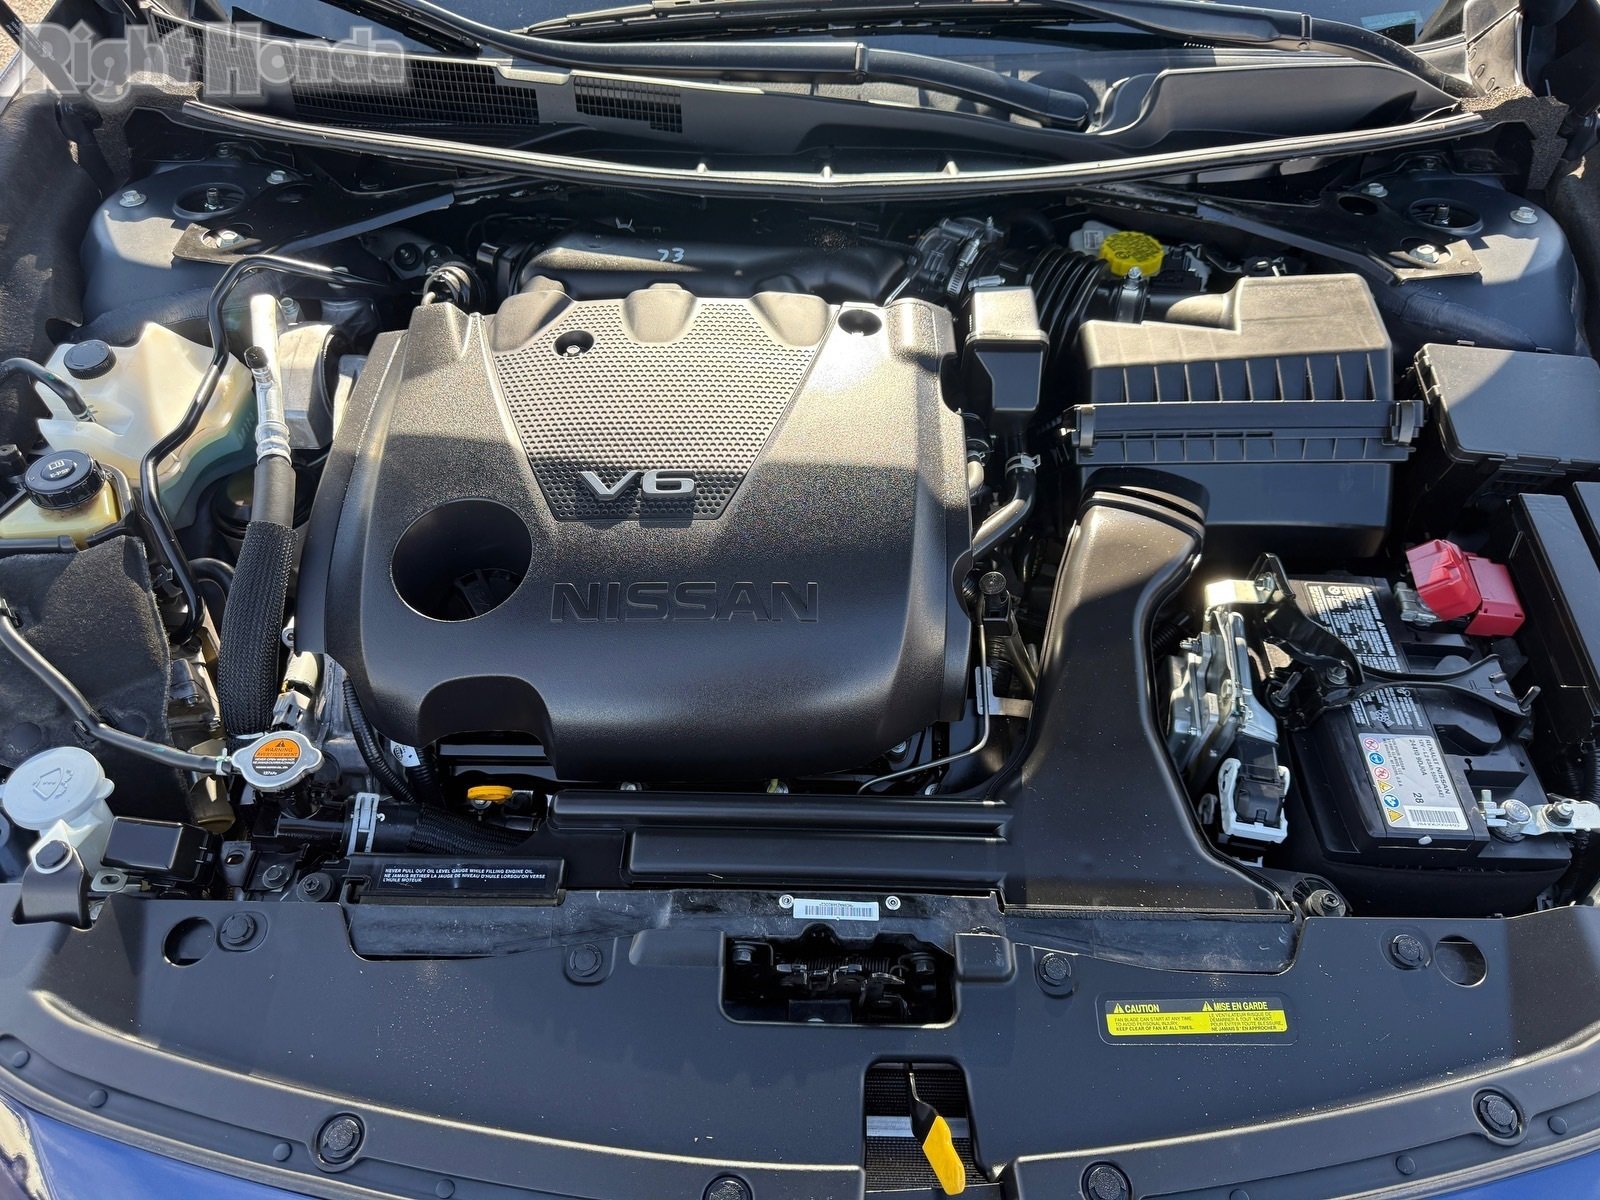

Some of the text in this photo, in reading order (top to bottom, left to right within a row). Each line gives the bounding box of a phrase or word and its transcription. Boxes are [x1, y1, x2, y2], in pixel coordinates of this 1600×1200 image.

[577, 470, 696, 500] V6
[550, 582, 819, 623] NISSAN
[1435, 767, 1450, 793] NISSAN
[1411, 792, 1424, 803] 28
[1125, 1004, 1160, 1013] CAUTION
[1214, 1002, 1268, 1011] MISE EN GARDE
